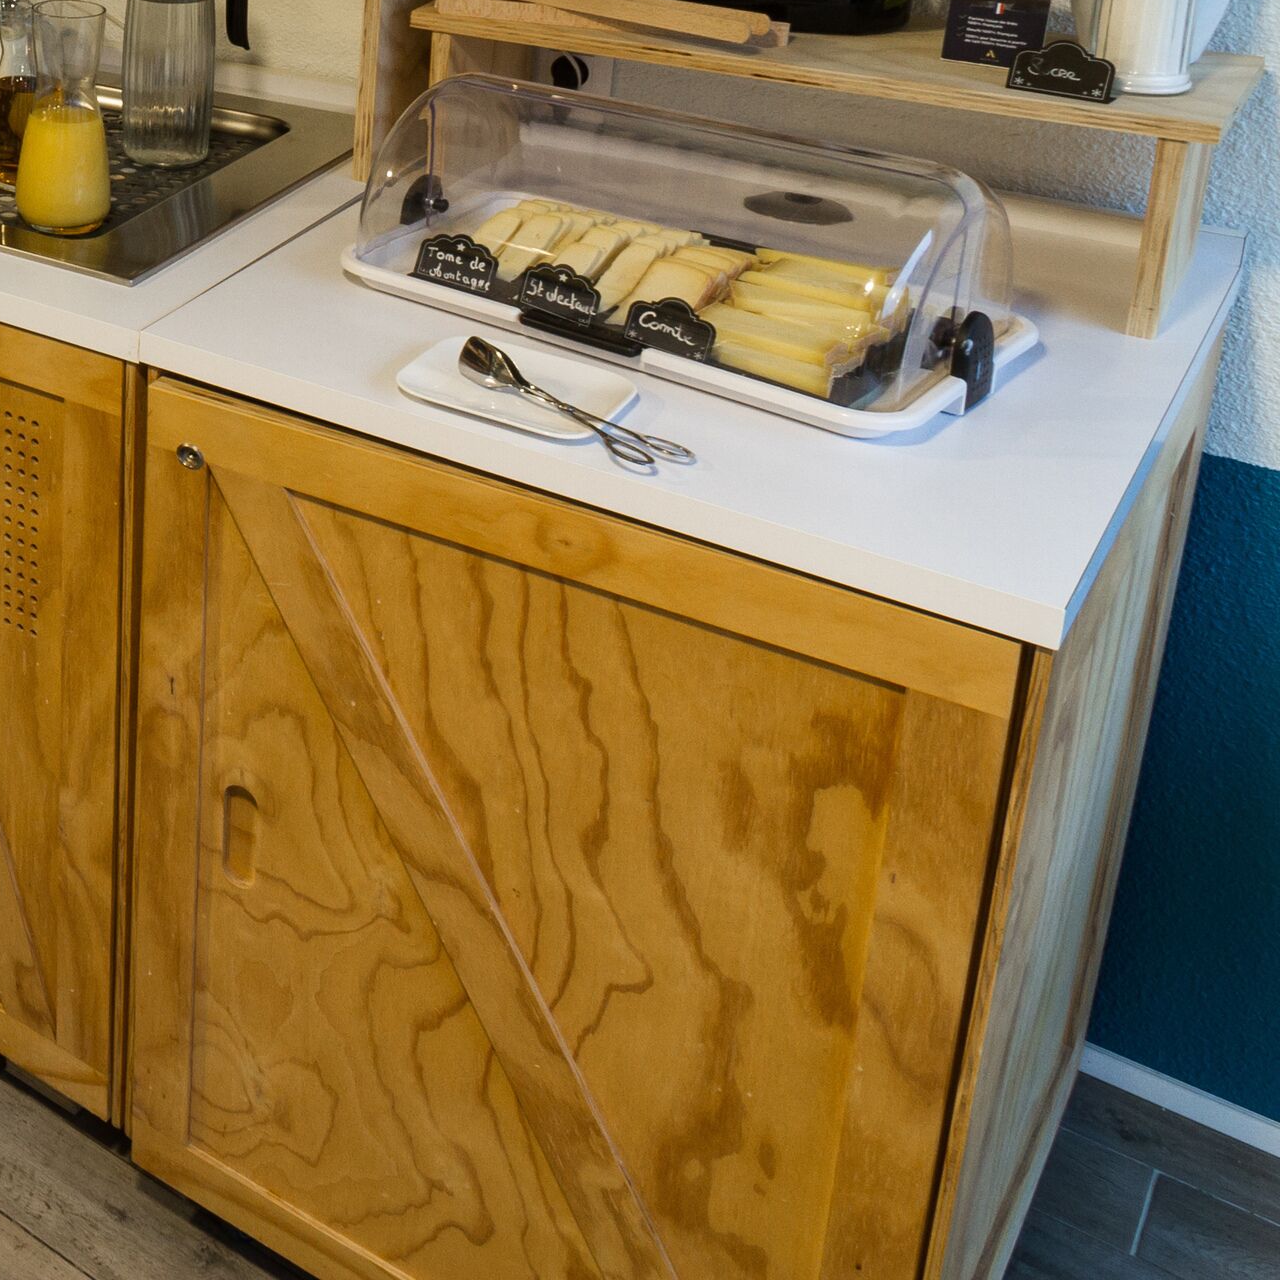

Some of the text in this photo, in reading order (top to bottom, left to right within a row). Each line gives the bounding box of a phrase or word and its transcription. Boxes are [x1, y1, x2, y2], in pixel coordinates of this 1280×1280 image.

[427, 246, 486, 272] Tome de
[526, 278, 544, 297] St
